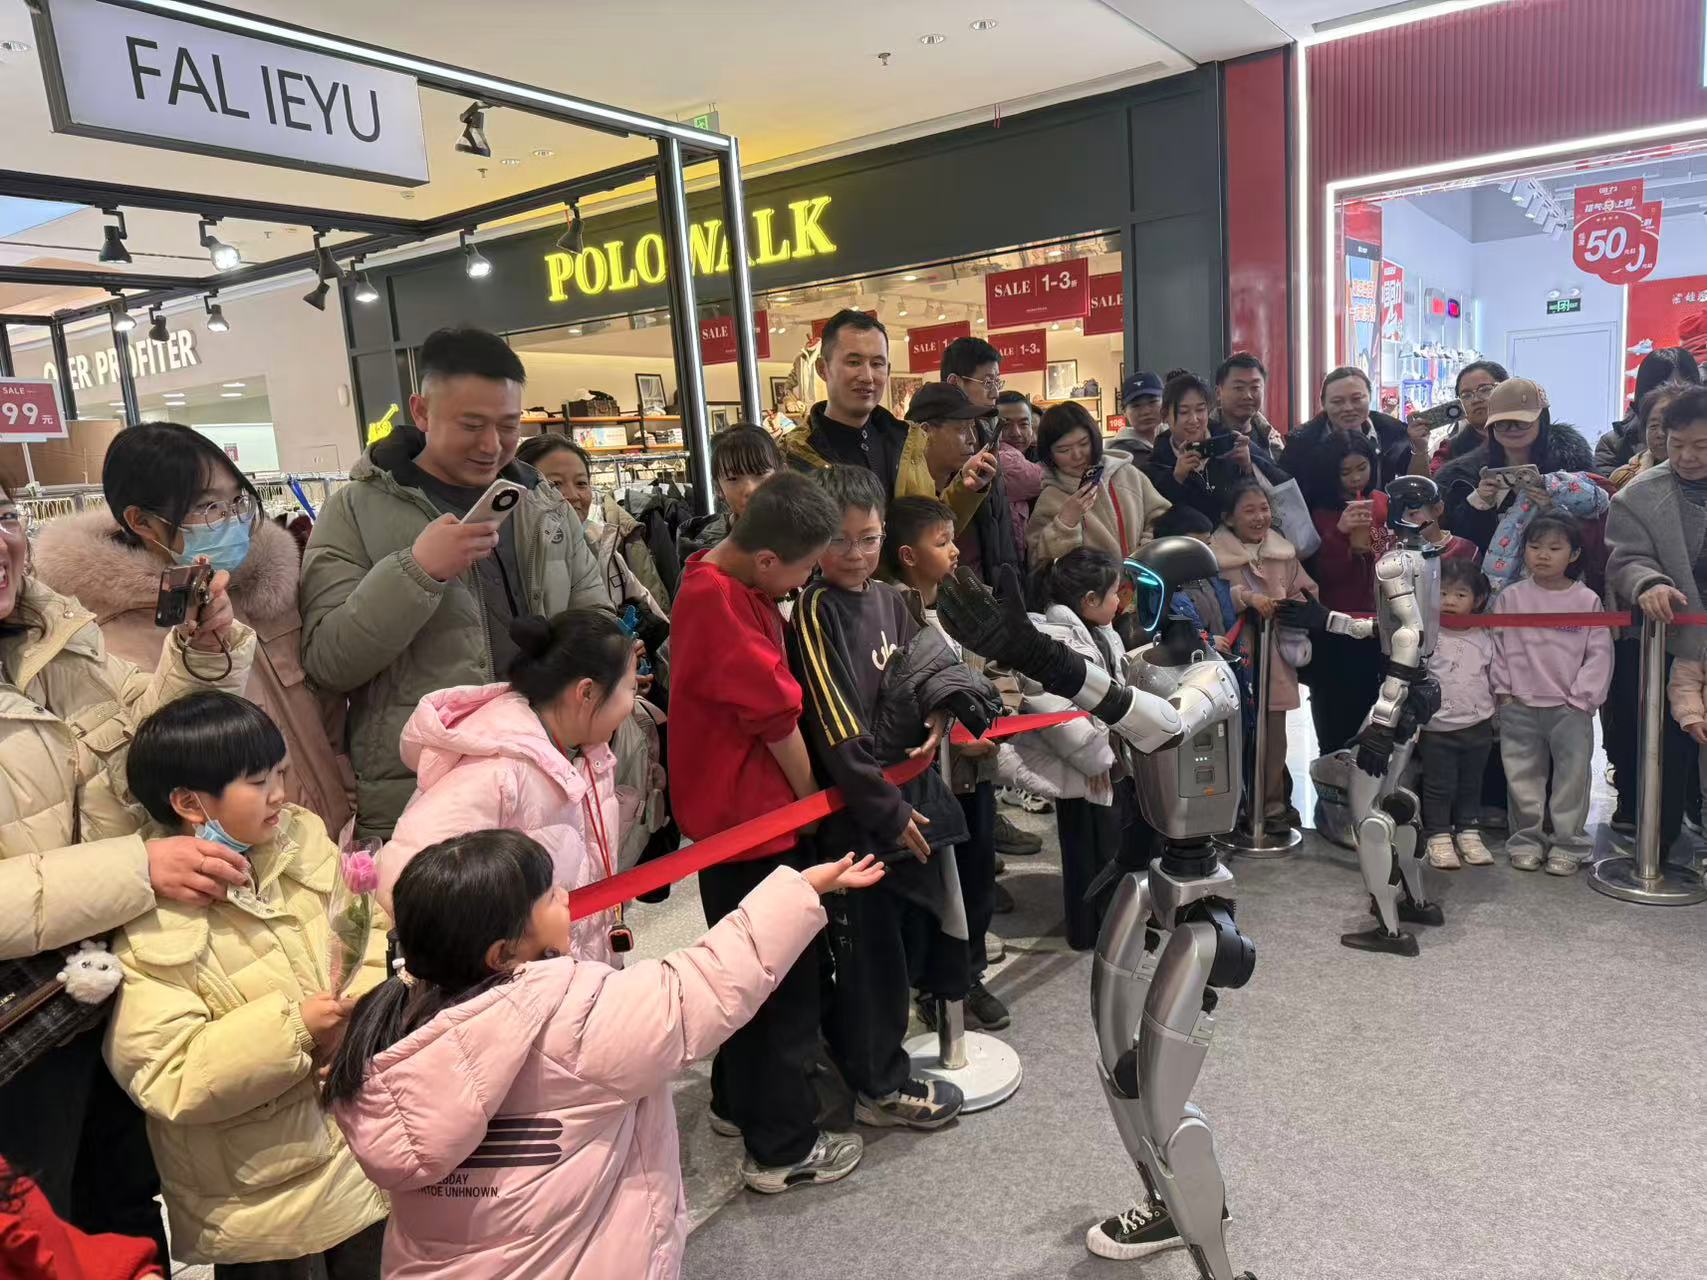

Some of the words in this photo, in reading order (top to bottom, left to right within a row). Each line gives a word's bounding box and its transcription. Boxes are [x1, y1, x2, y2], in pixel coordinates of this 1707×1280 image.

[125, 35, 250, 119] FAL
[260, 65, 382, 143] IEYU
[1584, 226, 1627, 262] 50
[994, 280, 1031, 298] SALE
[702, 326, 728, 340] SALE
[913, 341, 936, 354] SALE
[1000, 347, 1014, 357] ALE
[2, 387, 25, 395] SALE
